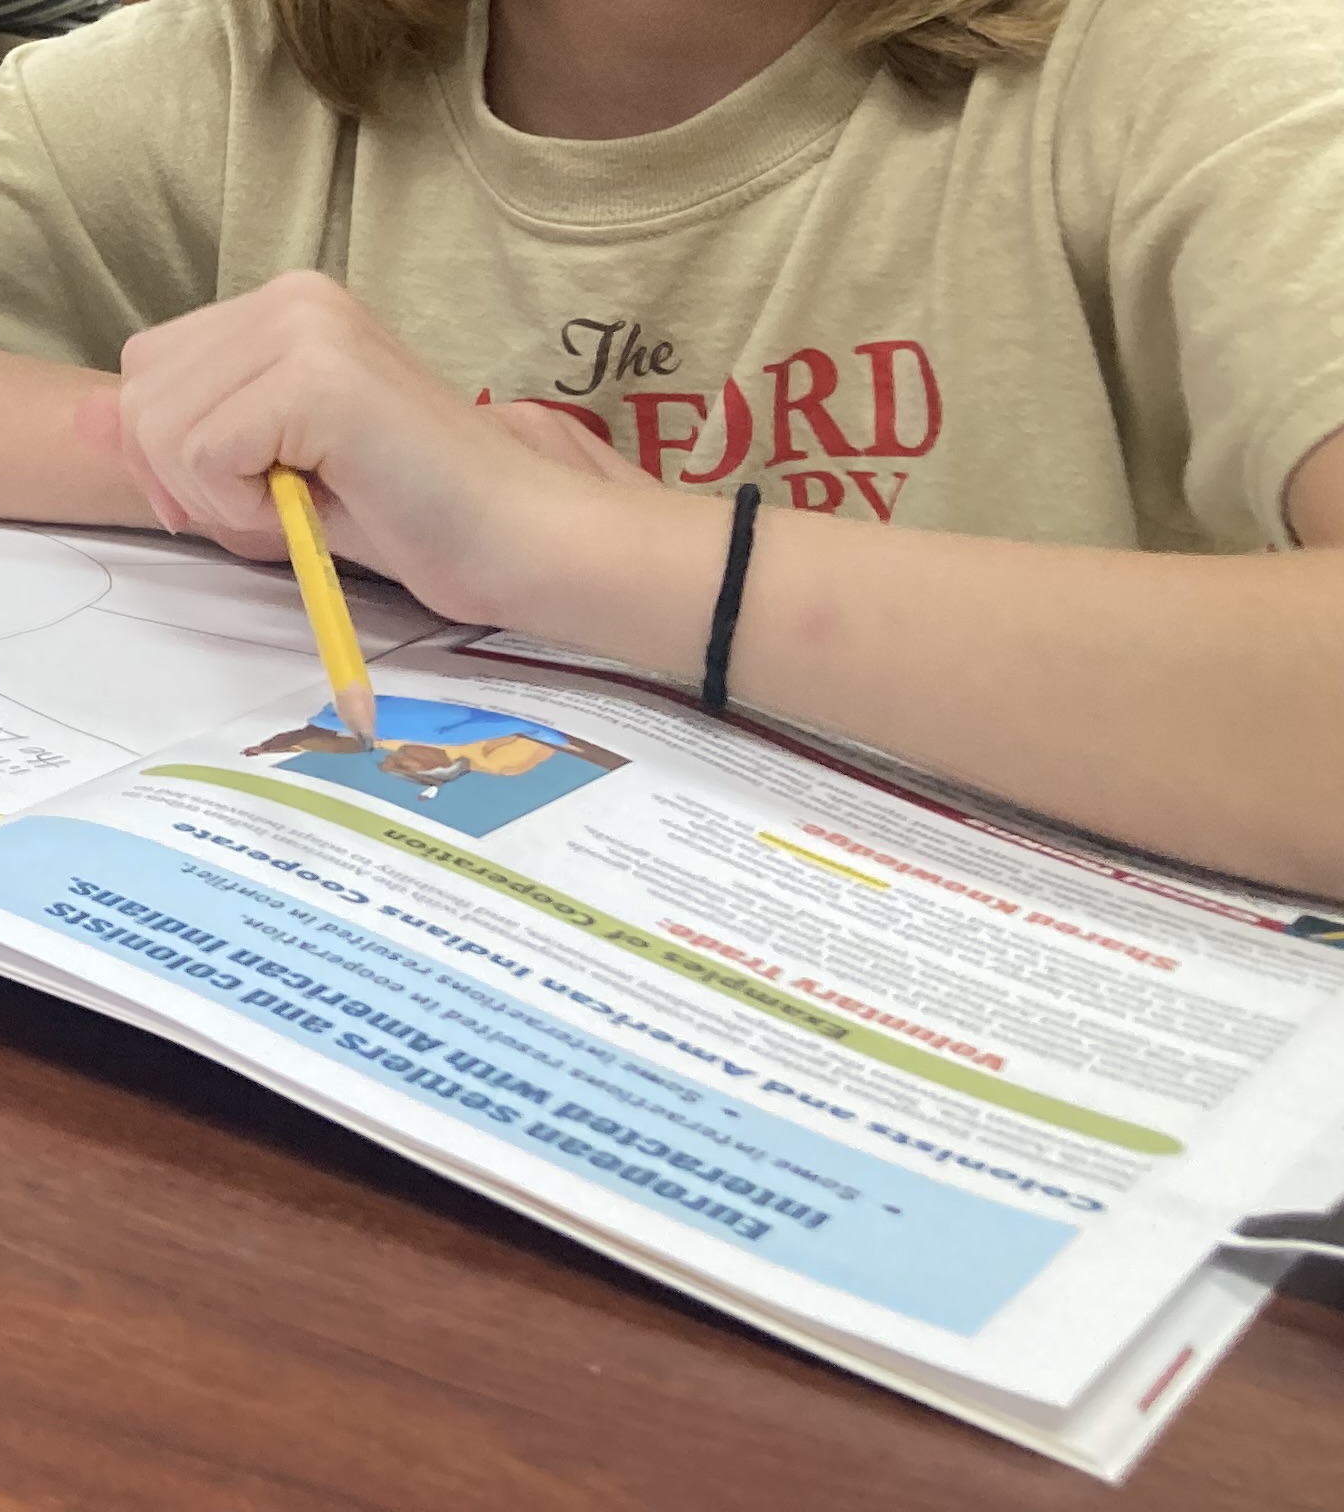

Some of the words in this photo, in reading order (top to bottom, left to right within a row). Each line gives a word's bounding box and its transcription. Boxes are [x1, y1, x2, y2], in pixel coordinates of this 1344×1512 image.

[554, 317, 683, 396] The
[170, 820, 371, 905] Cooperate
[178, 860, 287, 911] conflict.
[382, 828, 598, 928] Cooperation
[42, 899, 243, 992] colonists
[67, 875, 229, 954] Indians.
[239, 912, 406, 993] cooperation.
[287, 906, 318, 927] in
[311, 920, 434, 978] resulted
[375, 904, 534, 980] Indians
[603, 929, 652, 950] of
[1022, 910, 1181, 974] Shared
[226, 948, 445, 1055] American
[238, 985, 336, 1037] and
[409, 991, 443, 1013] in
[435, 974, 618, 1066] interactions
[540, 978, 758, 1078] American
[661, 950, 850, 1042] Examples
[787, 978, 1007, 1074] Voluntary
[334, 1031, 522, 1124] settlers
[436, 1008, 566, 1070] resulted
[442, 1050, 552, 1106] with
[568, 1067, 767, 1162] interactions
[619, 1061, 705, 1106] Some
[760, 1079, 859, 1122] and
[522, 1121, 772, 1243] European
[772, 1157, 863, 1202] Some
[866, 1122, 1108, 1215] Colonists
